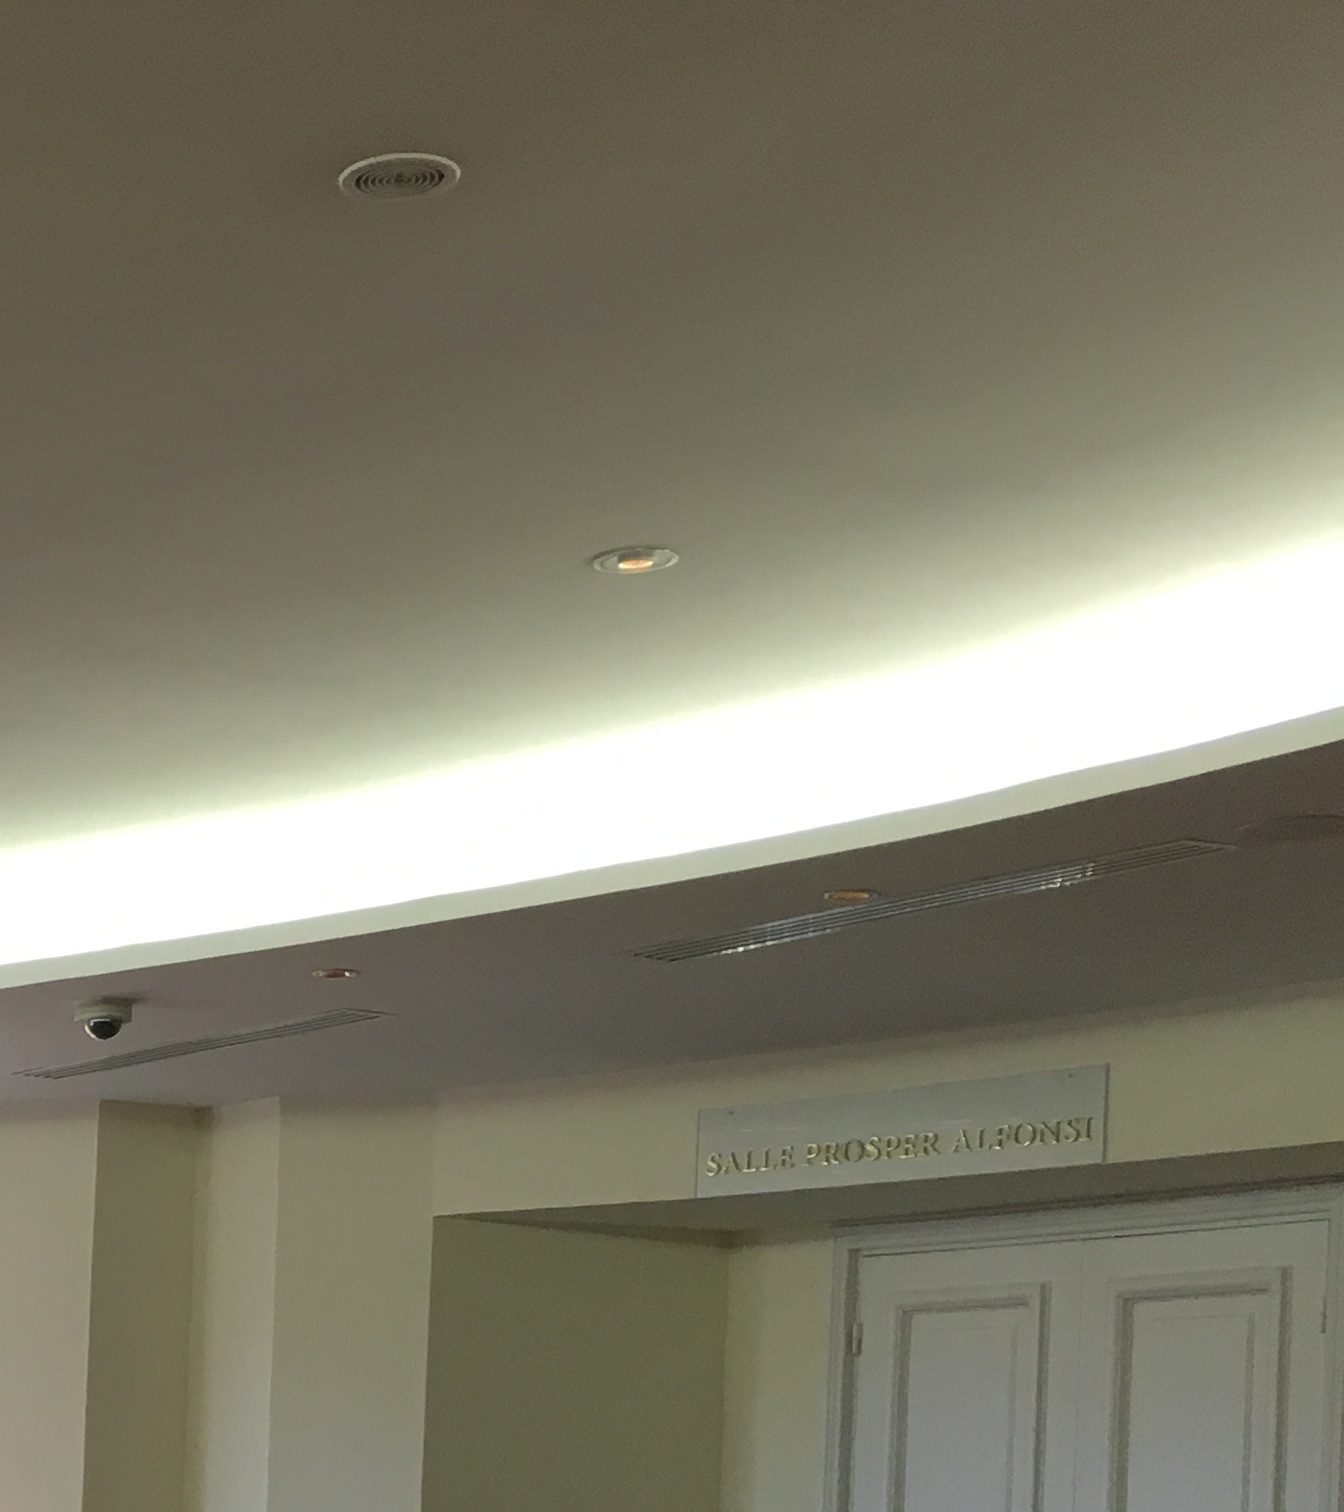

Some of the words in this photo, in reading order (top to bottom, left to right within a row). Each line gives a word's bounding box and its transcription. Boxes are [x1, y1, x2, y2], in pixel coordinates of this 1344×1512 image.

[705, 1145, 795, 1178] SALLE
[806, 1132, 940, 1166] PROSPER
[954, 1117, 1095, 1154] ALFONSI
